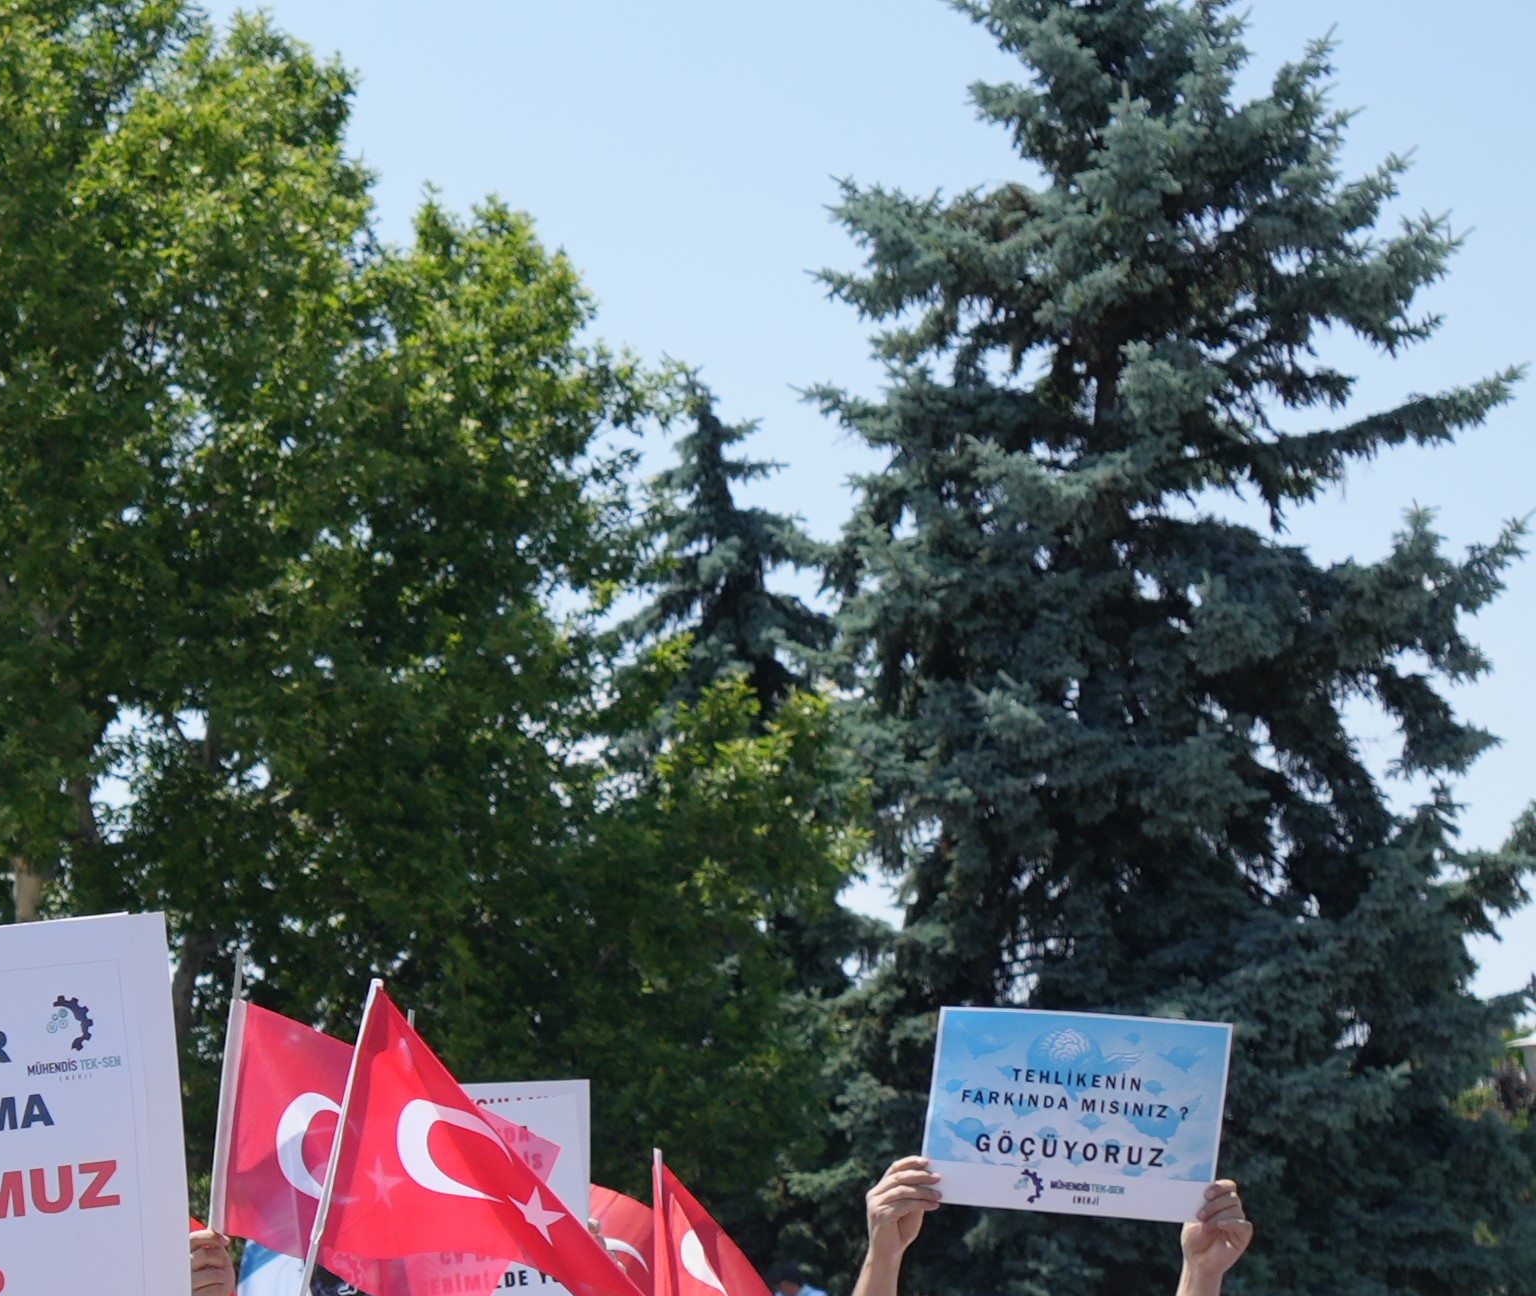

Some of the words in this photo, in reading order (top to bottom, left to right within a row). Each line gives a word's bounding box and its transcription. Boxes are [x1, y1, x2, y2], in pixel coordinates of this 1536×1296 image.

[27, 1058, 78, 1077] MÜHENDİS
[80, 1055, 122, 1071] TEK-SEN
[1012, 1067, 1143, 1092] TEHLİKENİN
[961, 1089, 1070, 1113] FARKINDA
[1080, 1097, 1168, 1120] MISINIZ
[975, 1128, 1165, 1170] GÖÇÜYORUZ
